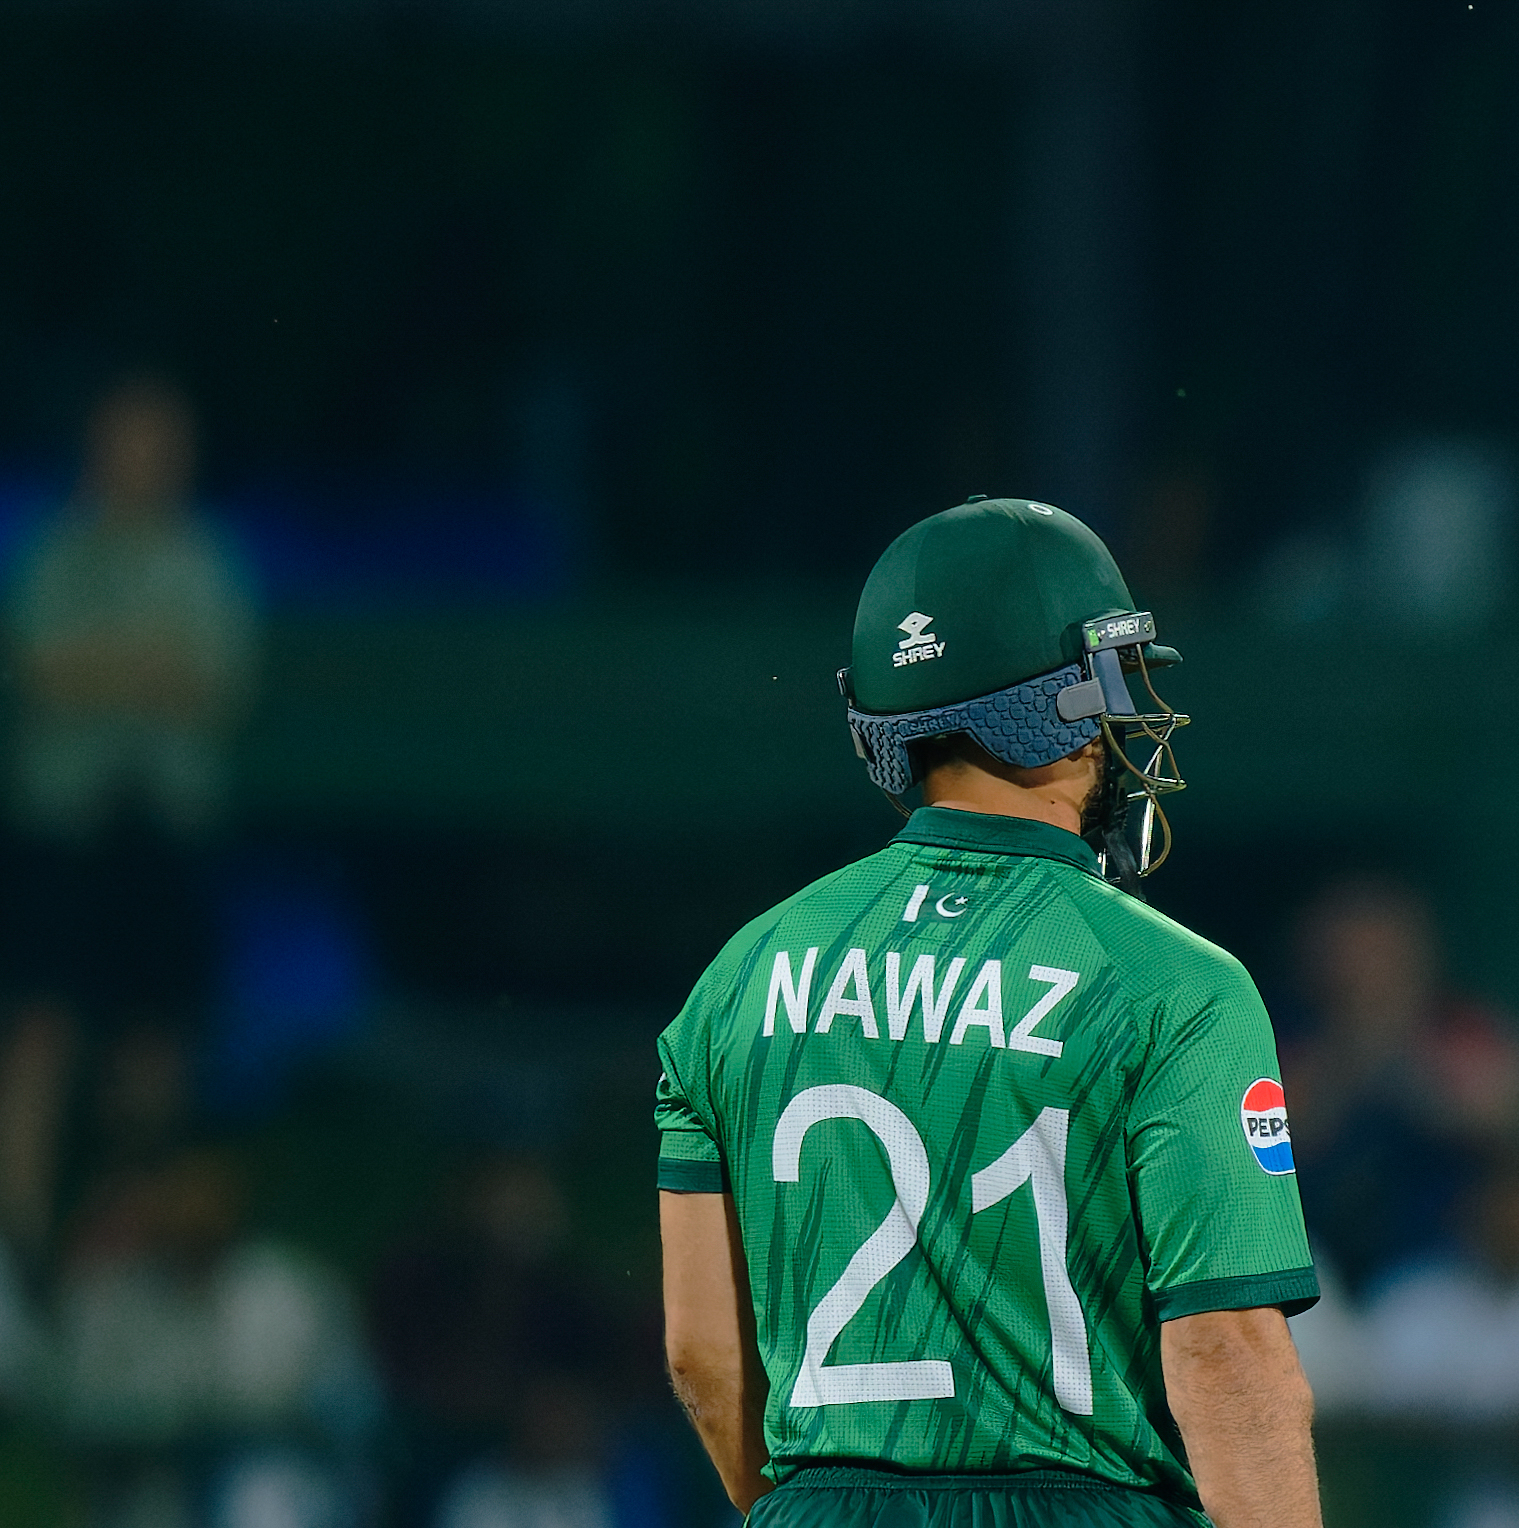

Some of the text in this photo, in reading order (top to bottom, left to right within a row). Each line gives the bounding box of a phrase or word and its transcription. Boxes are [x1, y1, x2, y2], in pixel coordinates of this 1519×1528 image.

[892, 641, 946, 668] SHREY
[1106, 618, 1140, 639] SHREY
[762, 947, 1080, 1059] NAWAZ
[772, 1084, 1094, 1417] 21
